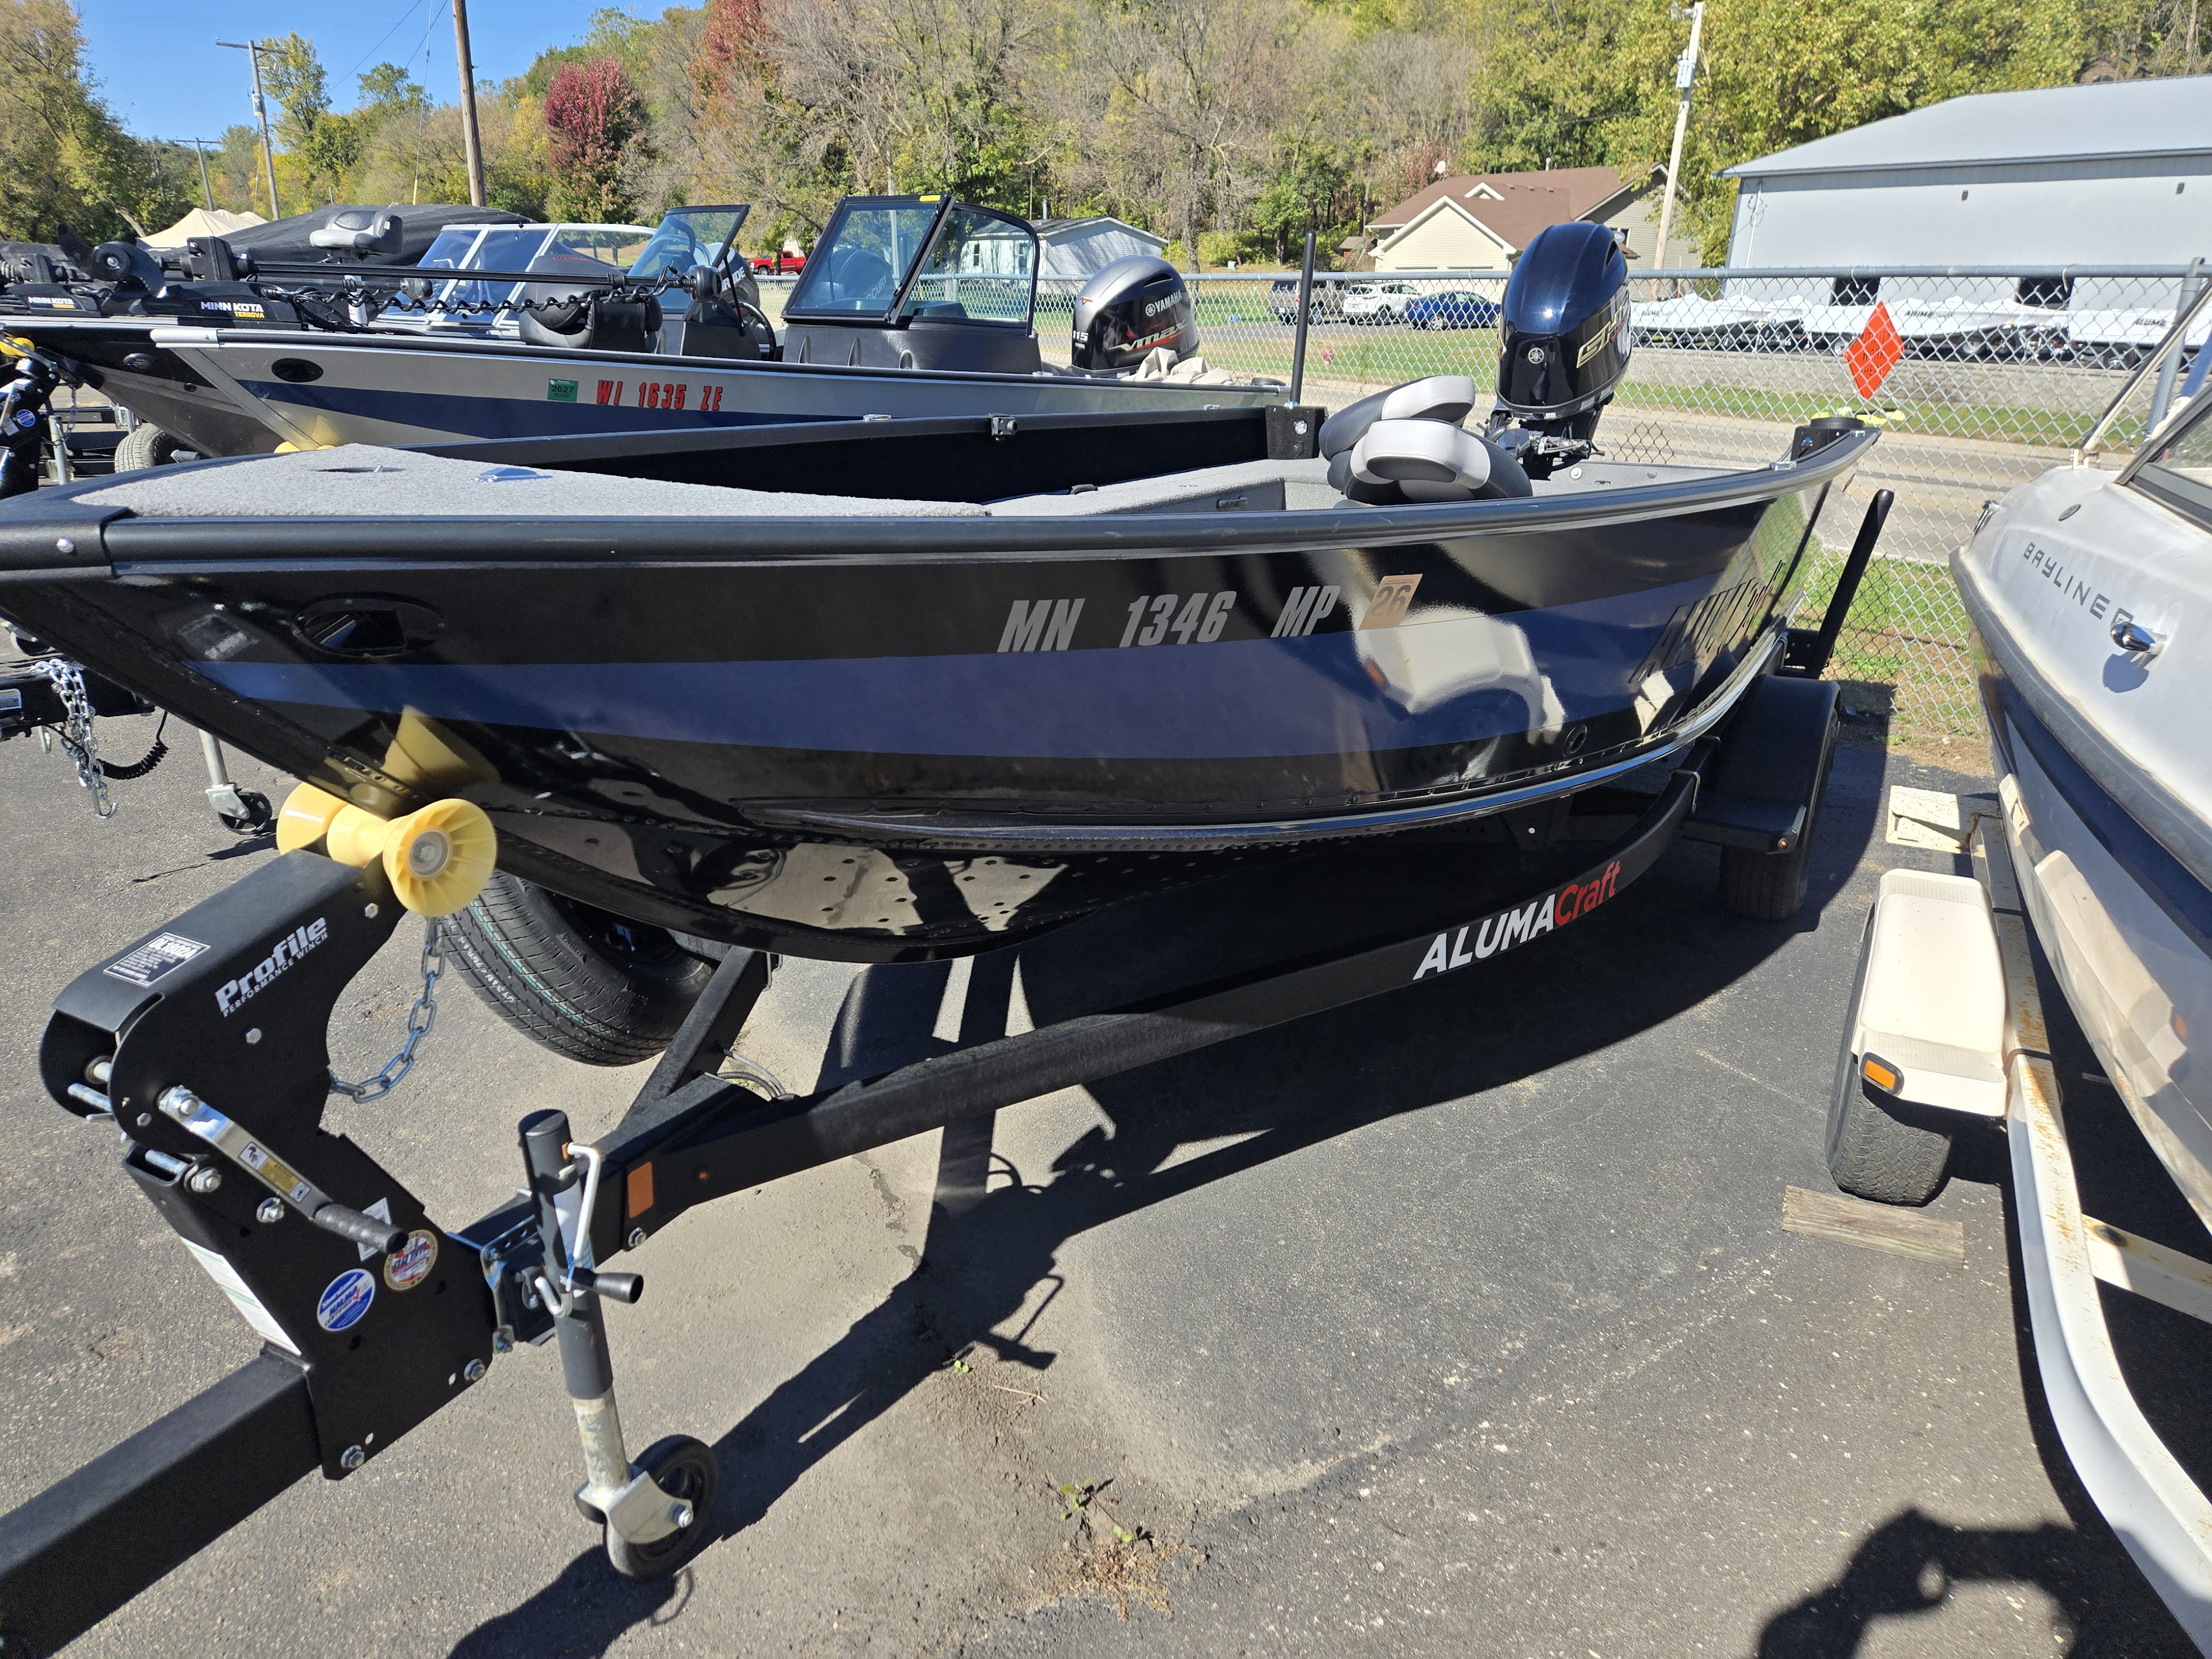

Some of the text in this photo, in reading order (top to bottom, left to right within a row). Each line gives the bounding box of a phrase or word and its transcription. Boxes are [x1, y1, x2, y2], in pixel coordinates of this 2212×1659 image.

[201, 301, 264, 312] MINN KOTA
[1154, 290, 1182, 312] YAMAHA
[1073, 330, 1089, 342] 115
[551, 385, 574, 393] 2027
[596, 380, 723, 411] WI 1635 ZE
[1367, 585, 1411, 619] 26
[997, 585, 1341, 653] MN 1346 MP
[215, 917, 327, 1012] Profile
[223, 958, 294, 1018] PERFORMANCE
[296, 932, 328, 959] WINCH
